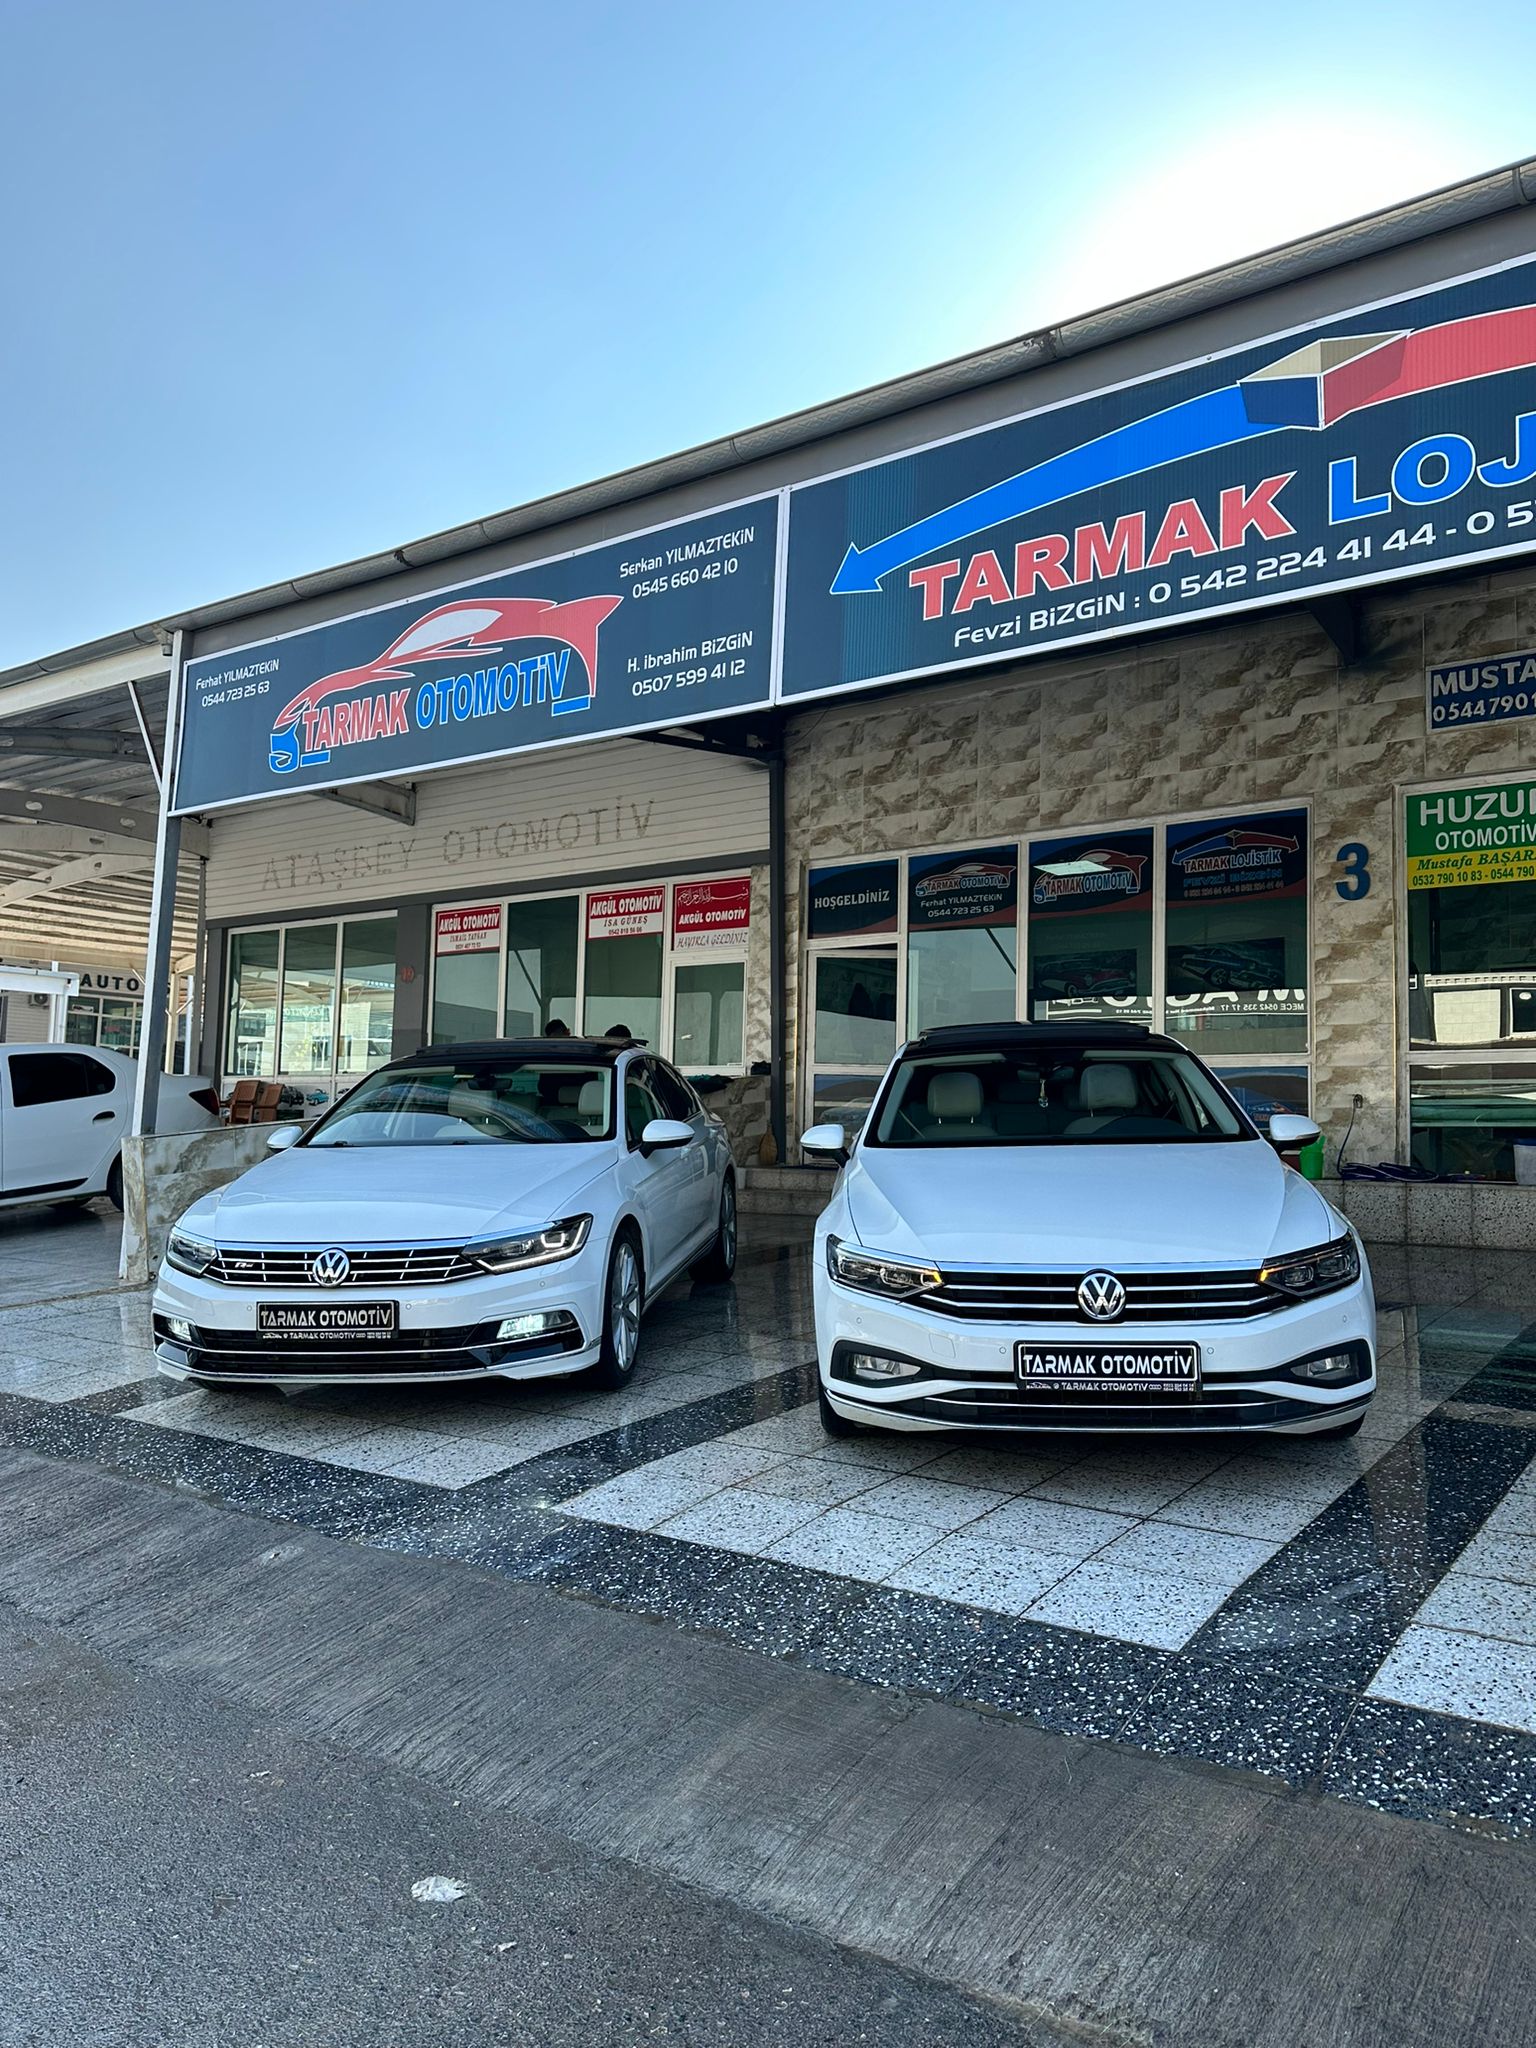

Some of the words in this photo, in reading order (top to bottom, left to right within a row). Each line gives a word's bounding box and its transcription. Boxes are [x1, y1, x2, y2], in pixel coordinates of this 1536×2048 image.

[909, 471, 1298, 621] TARMAK
[619, 556, 663, 578] Serkan
[632, 576, 669, 599] 0545
[670, 568, 699, 588] 660
[701, 562, 721, 580] 42
[724, 557, 739, 575] 10
[954, 614, 1022, 648] Fevzi
[1179, 565, 1248, 598] 542
[1256, 546, 1327, 581] 224
[1336, 536, 1372, 560] 41
[1382, 522, 1437, 552] 44
[627, 656, 641, 673] H.
[195, 673, 223, 691] Ferhat
[631, 674, 673, 697] 0507
[675, 667, 708, 687] 599
[710, 662, 726, 679] 41
[730, 658, 746, 676] 12
[201, 691, 225, 707] 0544
[225, 687, 243, 702] 723
[243, 683, 257, 697] 25
[257, 680, 270, 694] 63
[302, 687, 412, 753] TARMAK
[1183, 855, 1230, 874] TARMAK
[1229, 847, 1282, 869] LOJİSTİK
[1417, 855, 1473, 871] Mustafa
[1336, 842, 1371, 901] 3
[1412, 874, 1435, 887] 0532
[1437, 872, 1454, 884] 790
[1457, 871, 1468, 882] 10
[1470, 870, 1482, 881] 83
[1490, 868, 1514, 880] 0544
[1517, 865, 1535, 877] 790
[927, 877, 960, 892] TARMAK
[1045, 876, 1084, 896] TARMAK
[591, 896, 617, 916] AKGÜL
[814, 888, 891, 910] HOŞGELDİNİZ
[920, 898, 947, 908] Ferhat
[678, 910, 704, 925] AKGÜL
[927, 909, 951, 918] 0544
[952, 906, 969, 915] 723
[969, 905, 982, 914] 25
[982, 904, 995, 913] 63
[439, 913, 462, 933] AKGÜL
[79, 973, 140, 992] AUTO
[260, 1310, 316, 1327] TARMAK
[1023, 1354, 1097, 1375] TARMAK
[1061, 1382, 1100, 1391] TARMAK
